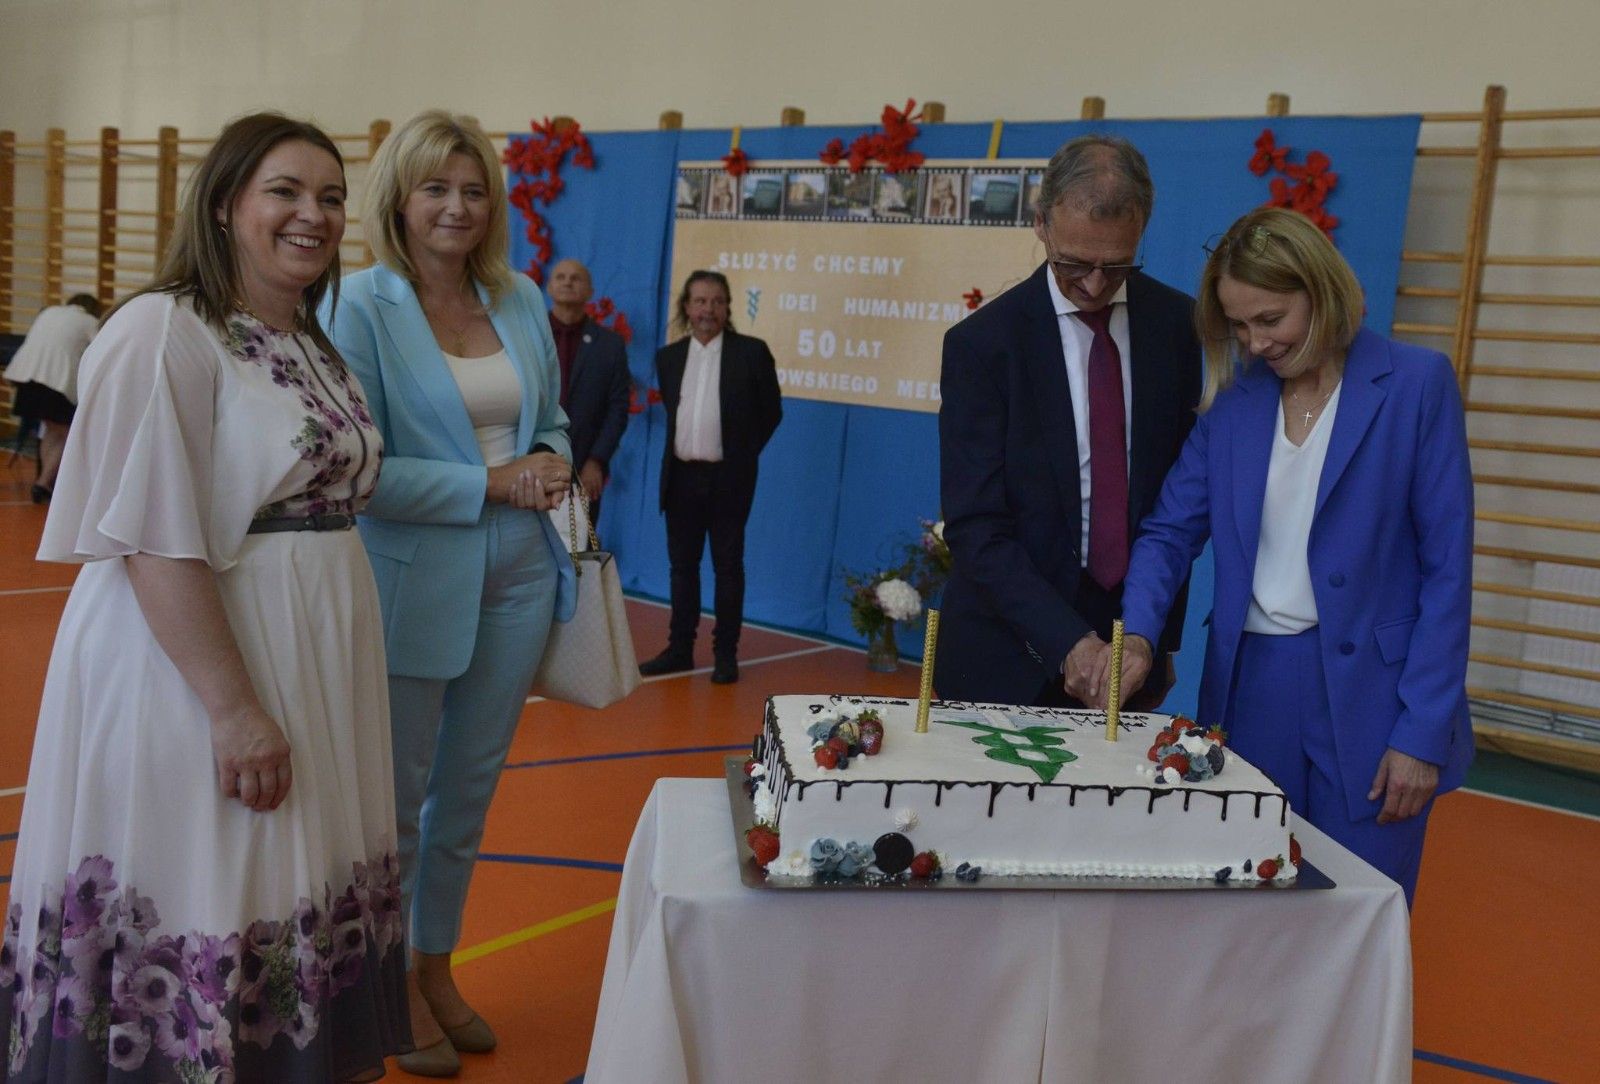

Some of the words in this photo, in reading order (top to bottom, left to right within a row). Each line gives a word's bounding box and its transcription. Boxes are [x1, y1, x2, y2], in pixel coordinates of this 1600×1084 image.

[814, 254, 905, 276] CHCEMY
[779, 293, 817, 312] IDEI
[798, 328, 837, 359] 50
[845, 338, 884, 358] LAT
[777, 368, 879, 394] OWSKIEGO
[897, 378, 942, 401] MED
